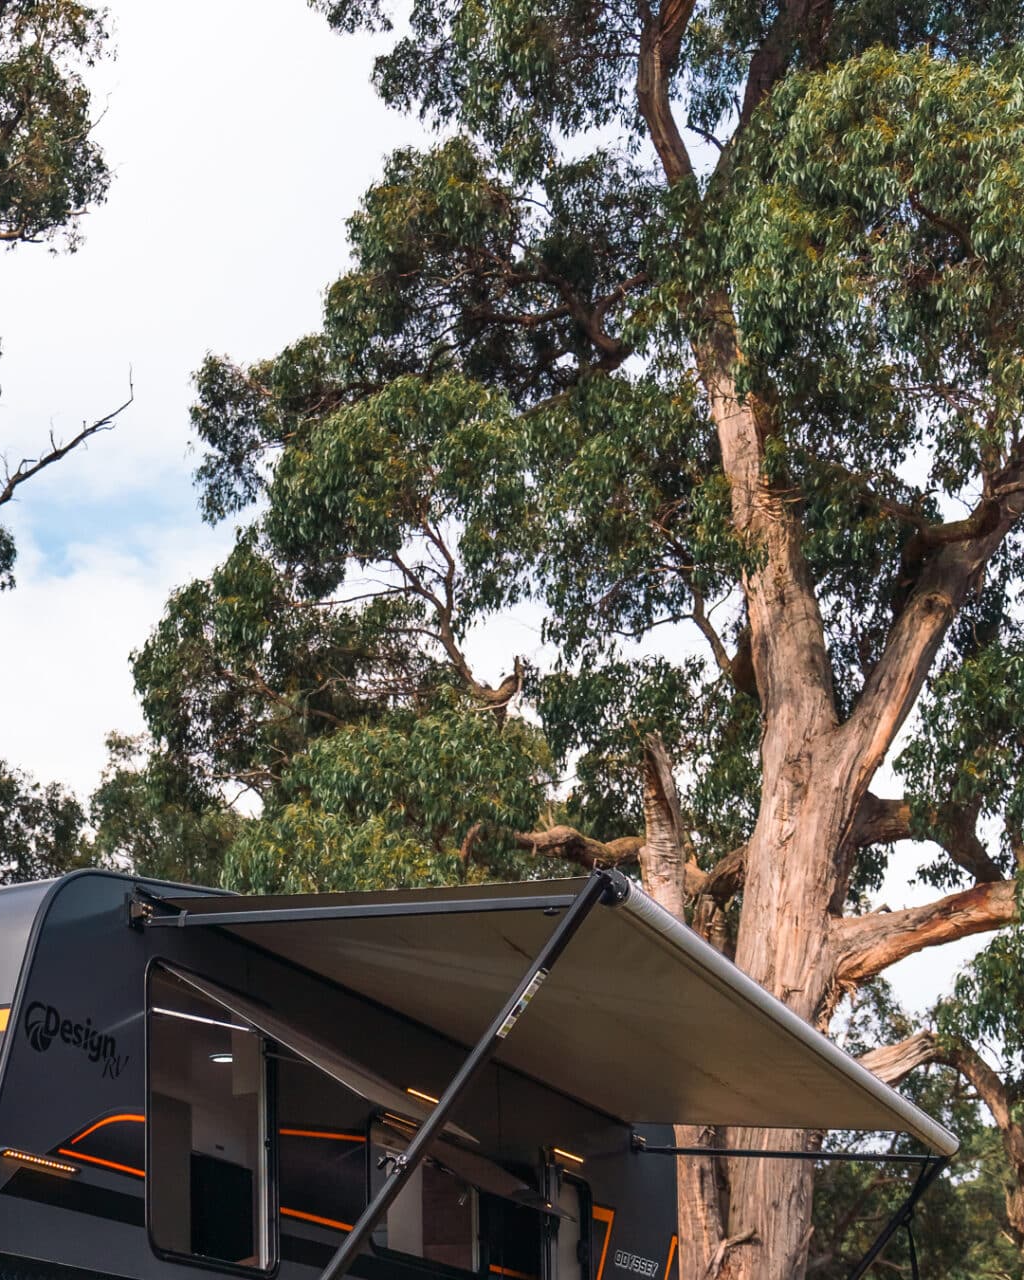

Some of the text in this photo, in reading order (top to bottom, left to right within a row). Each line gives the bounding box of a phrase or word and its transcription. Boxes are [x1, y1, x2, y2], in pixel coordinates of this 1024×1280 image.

[45, 1005, 130, 1080] Design RV
[615, 1249, 659, 1278] ODYSSEY
